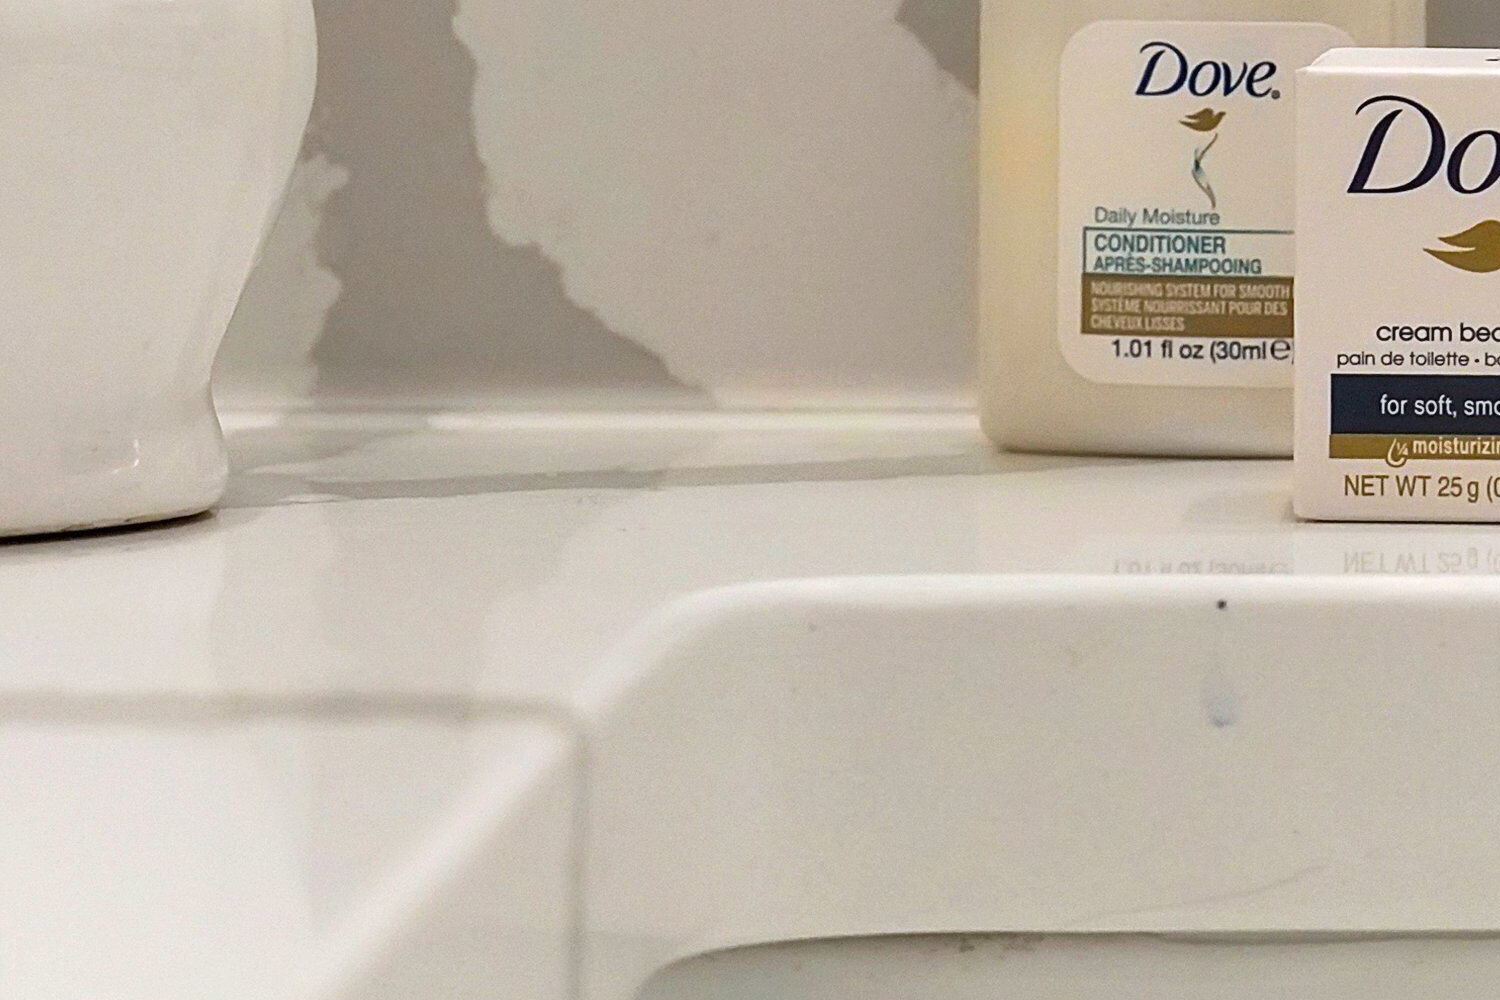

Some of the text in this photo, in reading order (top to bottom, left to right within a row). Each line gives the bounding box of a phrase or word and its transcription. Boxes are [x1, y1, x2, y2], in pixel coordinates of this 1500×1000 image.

[1135, 41, 1277, 98] Dove
[1095, 207, 1220, 228] Daily Moisture
[1094, 234, 1226, 254] CONDITIONER
[1094, 254, 1262, 275] APRÈS-SHAMPOOING
[1166, 283, 1211, 298] SYSTEM
[1213, 284, 1236, 298] FOR
[1239, 284, 1290, 299] SMOOTH
[1229, 302, 1262, 315] POUR
[1264, 302, 1288, 316] DES
[1145, 317, 1185, 331] LISSES
[1376, 325, 1452, 342] cream
[1112, 339, 1152, 357] 1.01
[1161, 339, 1173, 357] fl
[1179, 344, 1204, 359] oz
[1337, 350, 1375, 368] pain
[1381, 351, 1404, 366] de
[1410, 351, 1469, 366] toilette
[1380, 394, 1407, 415] for
[1414, 394, 1457, 418] soft,
[1344, 475, 1389, 497] NET
[1395, 475, 1432, 497] WT
